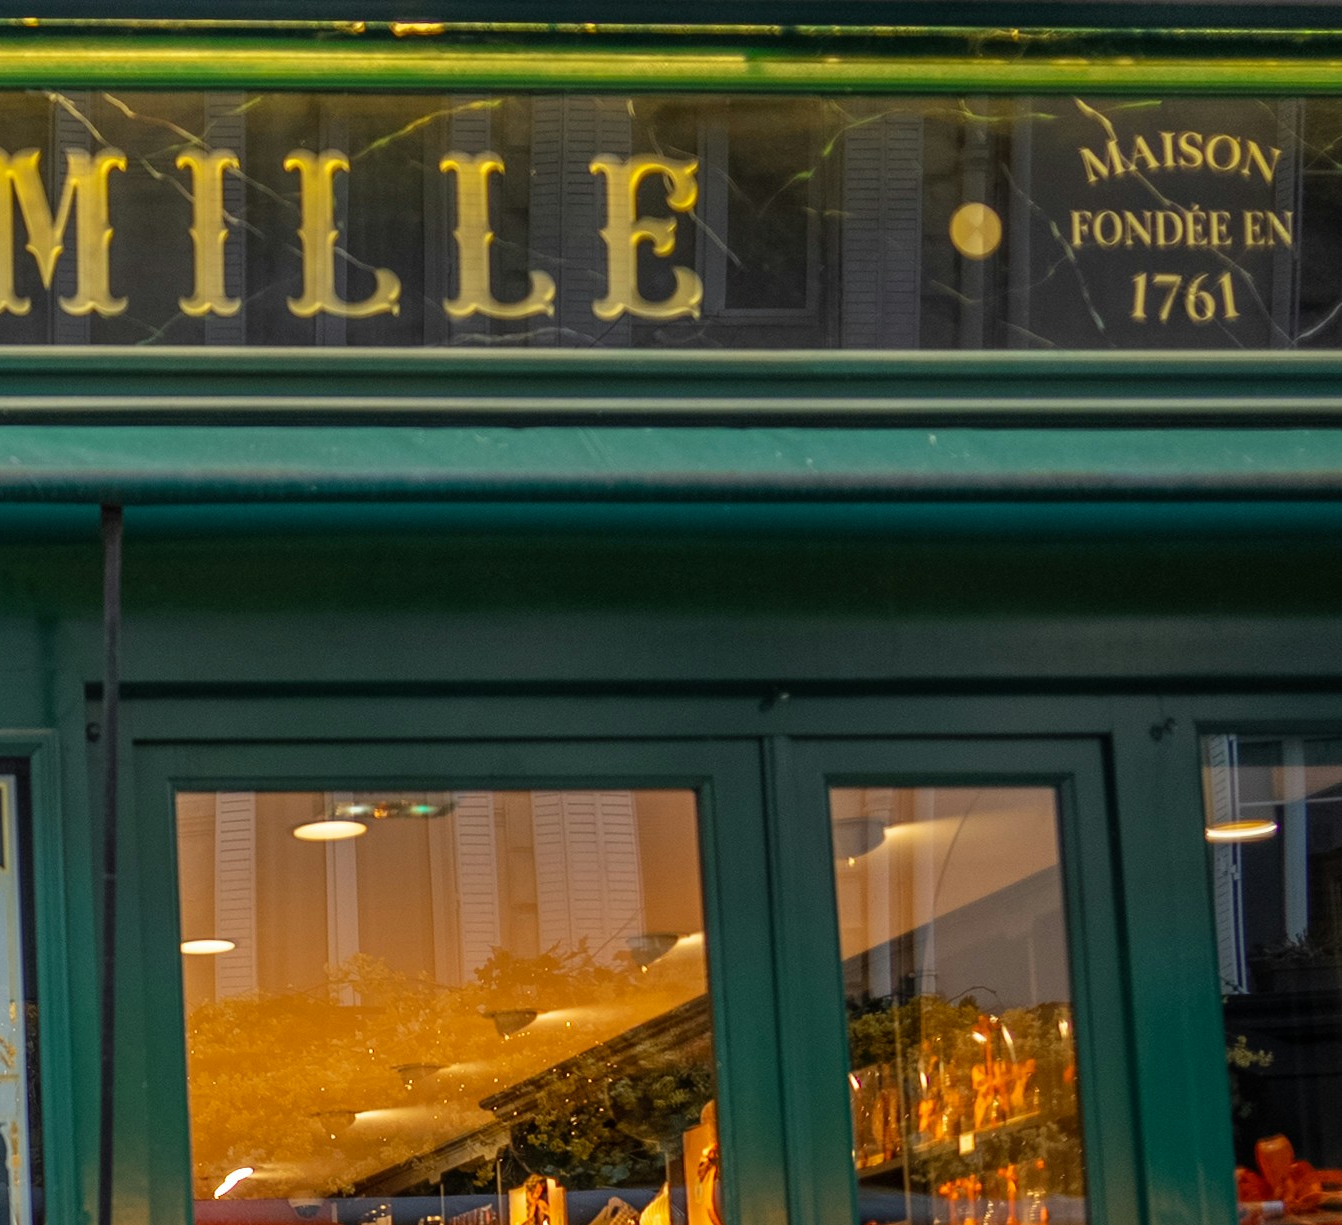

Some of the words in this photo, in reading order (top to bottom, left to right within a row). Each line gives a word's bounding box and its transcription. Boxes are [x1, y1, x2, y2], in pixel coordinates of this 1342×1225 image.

[1078, 130, 1283, 184] MAISON
[1069, 203, 1232, 249] FONDÉE
[1243, 209, 1294, 249] EN
[1130, 271, 1240, 324] 1761
